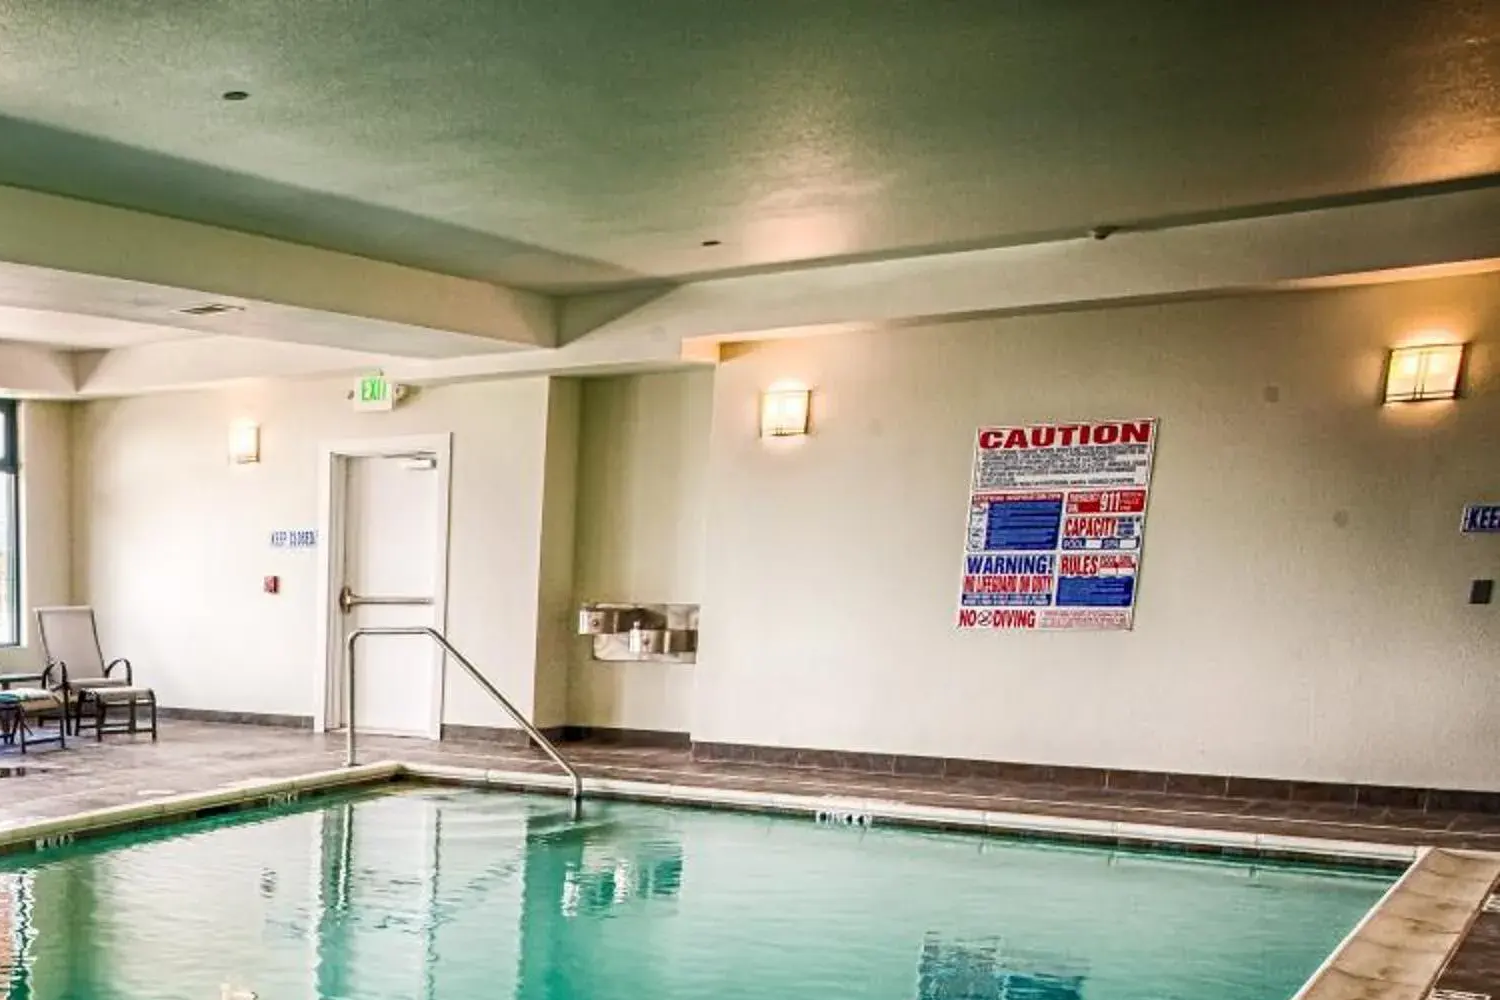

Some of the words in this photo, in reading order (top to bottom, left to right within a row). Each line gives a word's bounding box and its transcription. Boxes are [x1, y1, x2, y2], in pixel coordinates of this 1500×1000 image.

[361, 379, 387, 400] EXIT
[979, 423, 1150, 449] CAUTION
[1100, 491, 1120, 512] 911
[1063, 516, 1116, 536] CAPACITY
[967, 555, 1052, 574] WARNING!
[1061, 554, 1098, 574] RULES
[959, 609, 977, 627] NO
[993, 609, 1036, 628] DIVING
